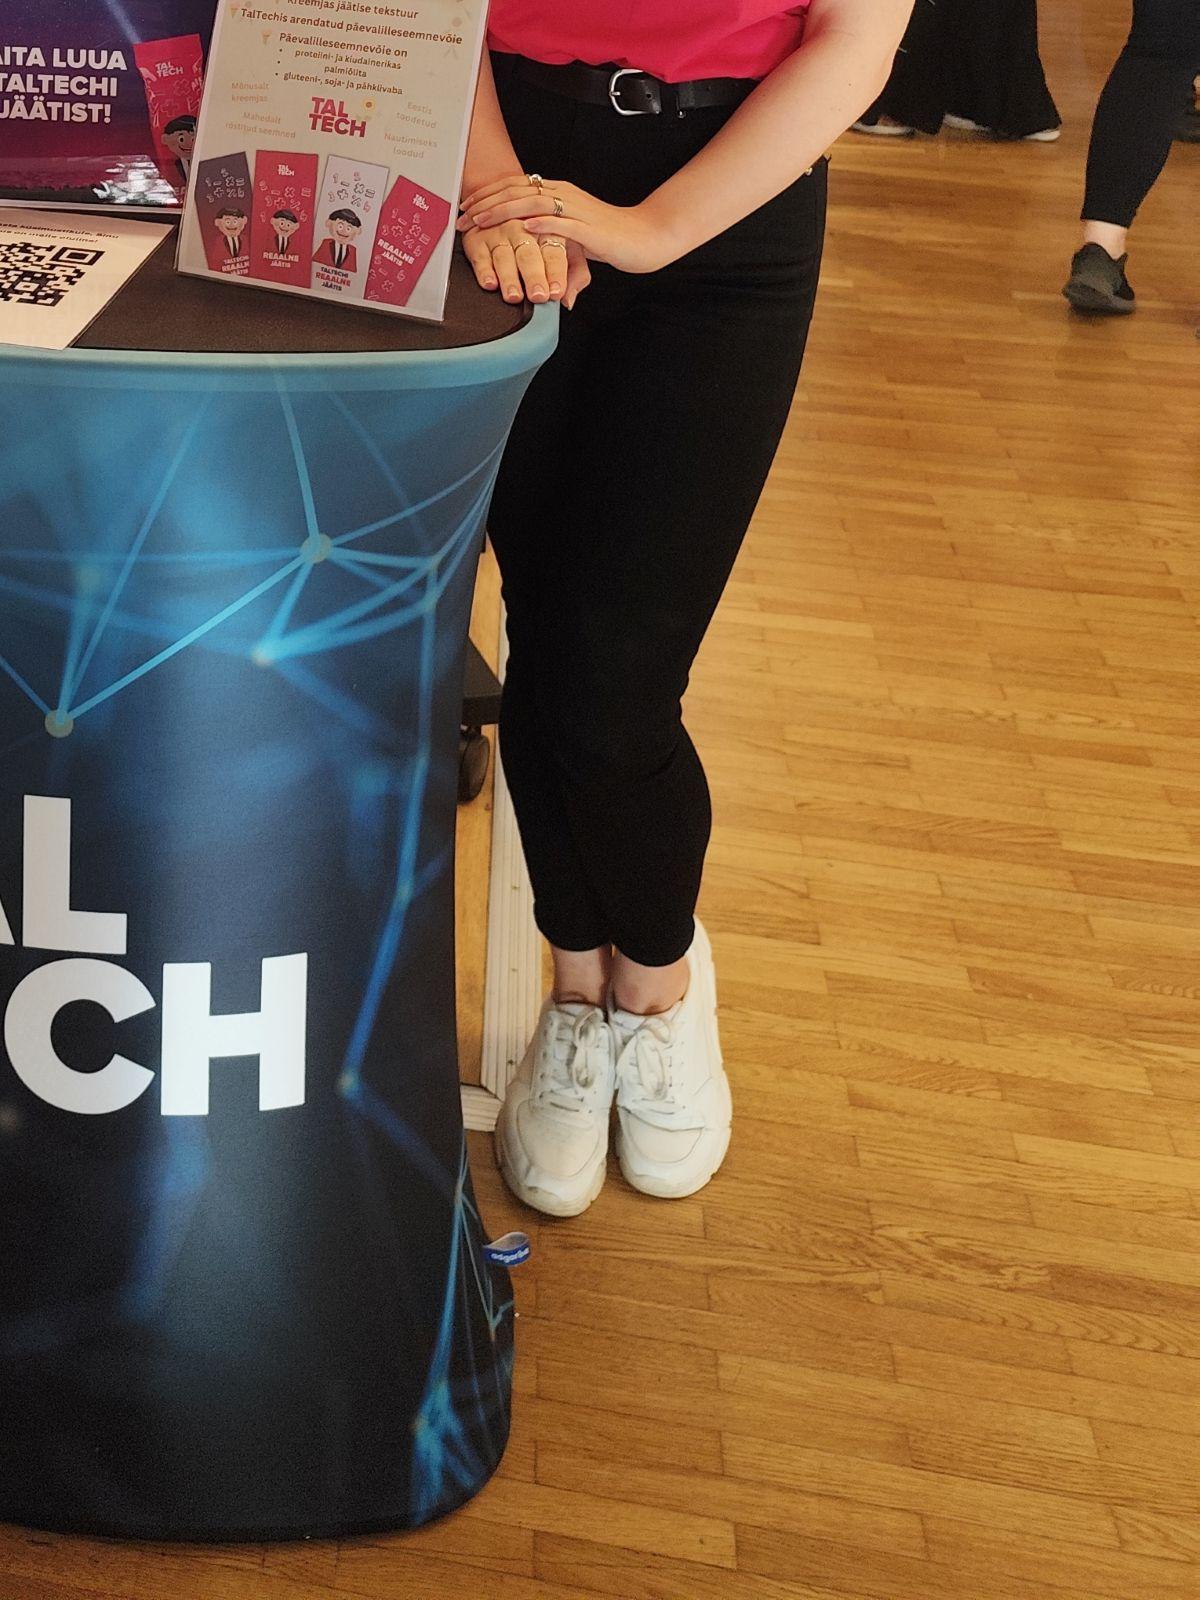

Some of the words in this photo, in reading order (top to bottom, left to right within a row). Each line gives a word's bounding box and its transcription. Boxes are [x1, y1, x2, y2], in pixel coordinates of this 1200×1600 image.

[240, 7, 289, 23] TalTechis
[288, 13, 344, 30] arendatud
[335, 0, 372, 15] jäätise
[372, 3, 419, 19] tekstuur
[53, 48, 127, 71] LUUA
[333, 52, 344, 64] ja
[343, 54, 402, 71] kiudainerikas
[393, 48, 408, 58] on
[155, 63, 174, 72] TAL
[156, 66, 184, 77] TECH
[323, 76, 346, 89] soja-
[345, 79, 355, 91] ja
[312, 96, 348, 118] TAL
[309, 113, 366, 138] TECH
[263, 252, 299, 262] REAALNE
[378, 239, 415, 264] REAALNE
[316, 272, 351, 286] REAALNE
